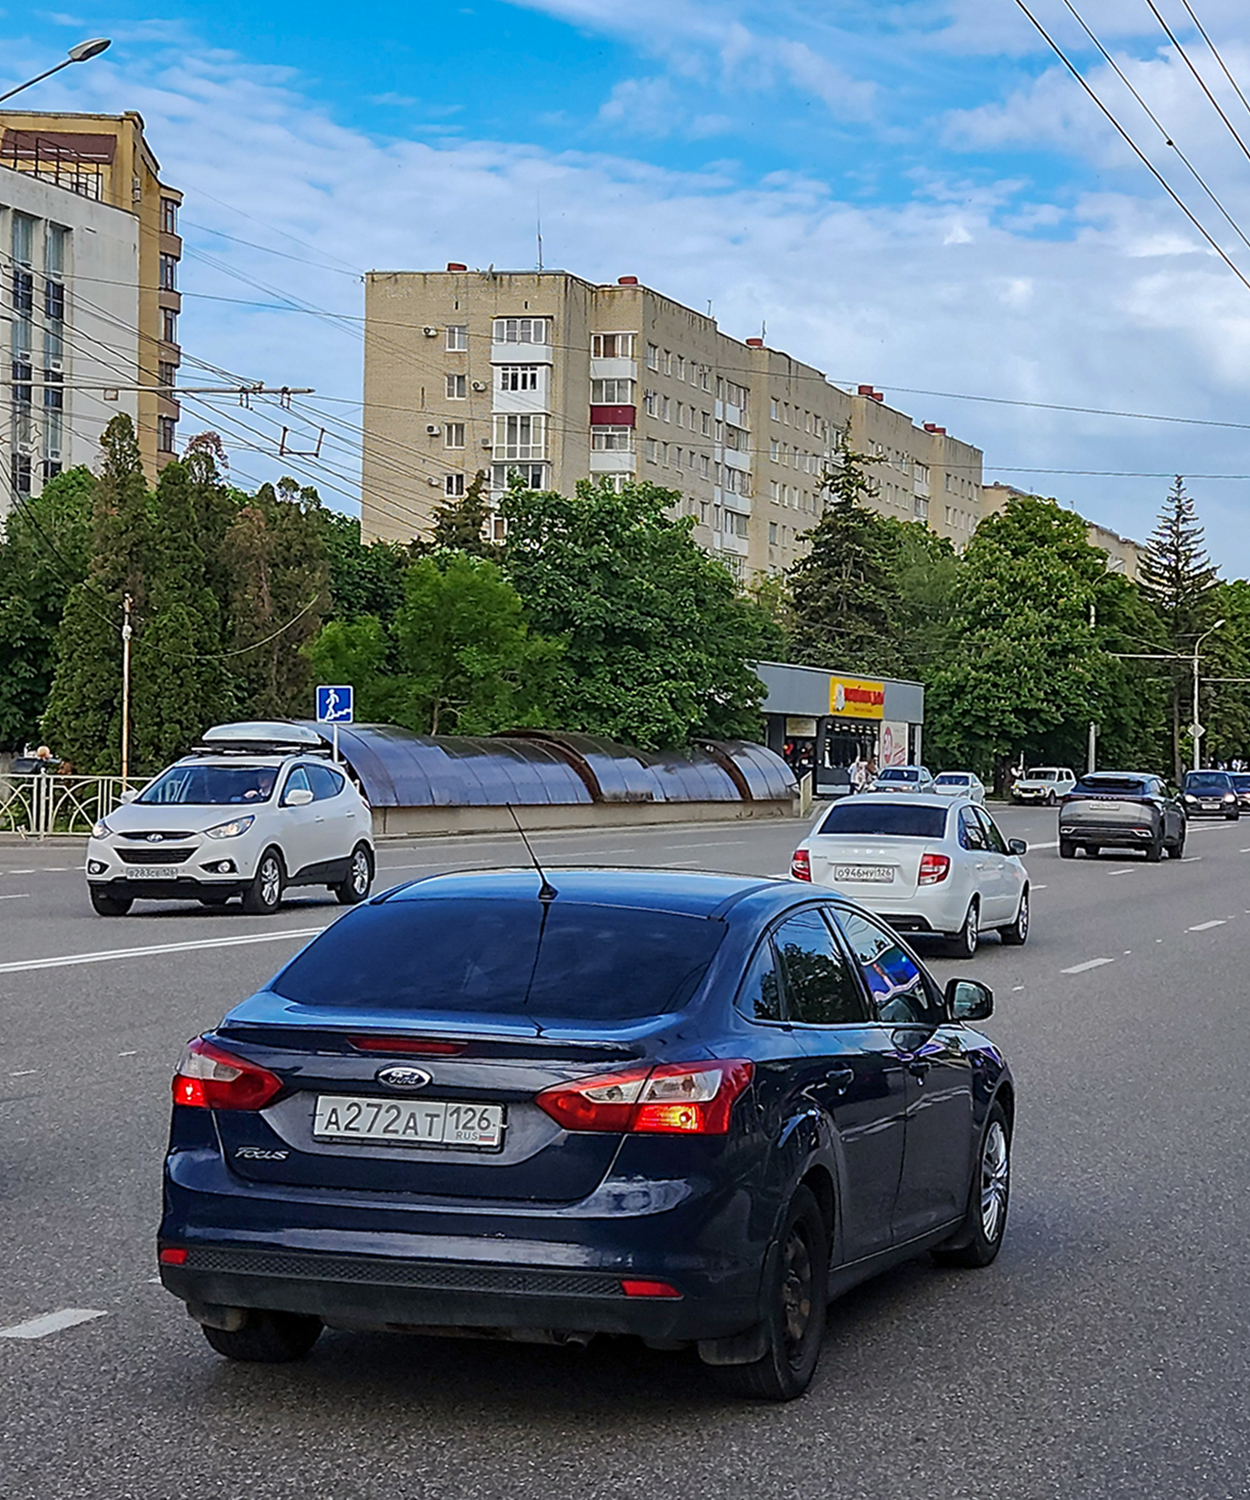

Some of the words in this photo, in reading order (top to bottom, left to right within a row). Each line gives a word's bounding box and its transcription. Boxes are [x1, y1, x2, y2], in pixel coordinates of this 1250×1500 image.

[838, 867, 874, 878] О946МУ
[876, 867, 891, 877] 126
[388, 1070, 420, 1085] Ford
[324, 1102, 441, 1137] А272АТ
[449, 1105, 492, 1131] 126
[456, 1131, 478, 1141] RUS
